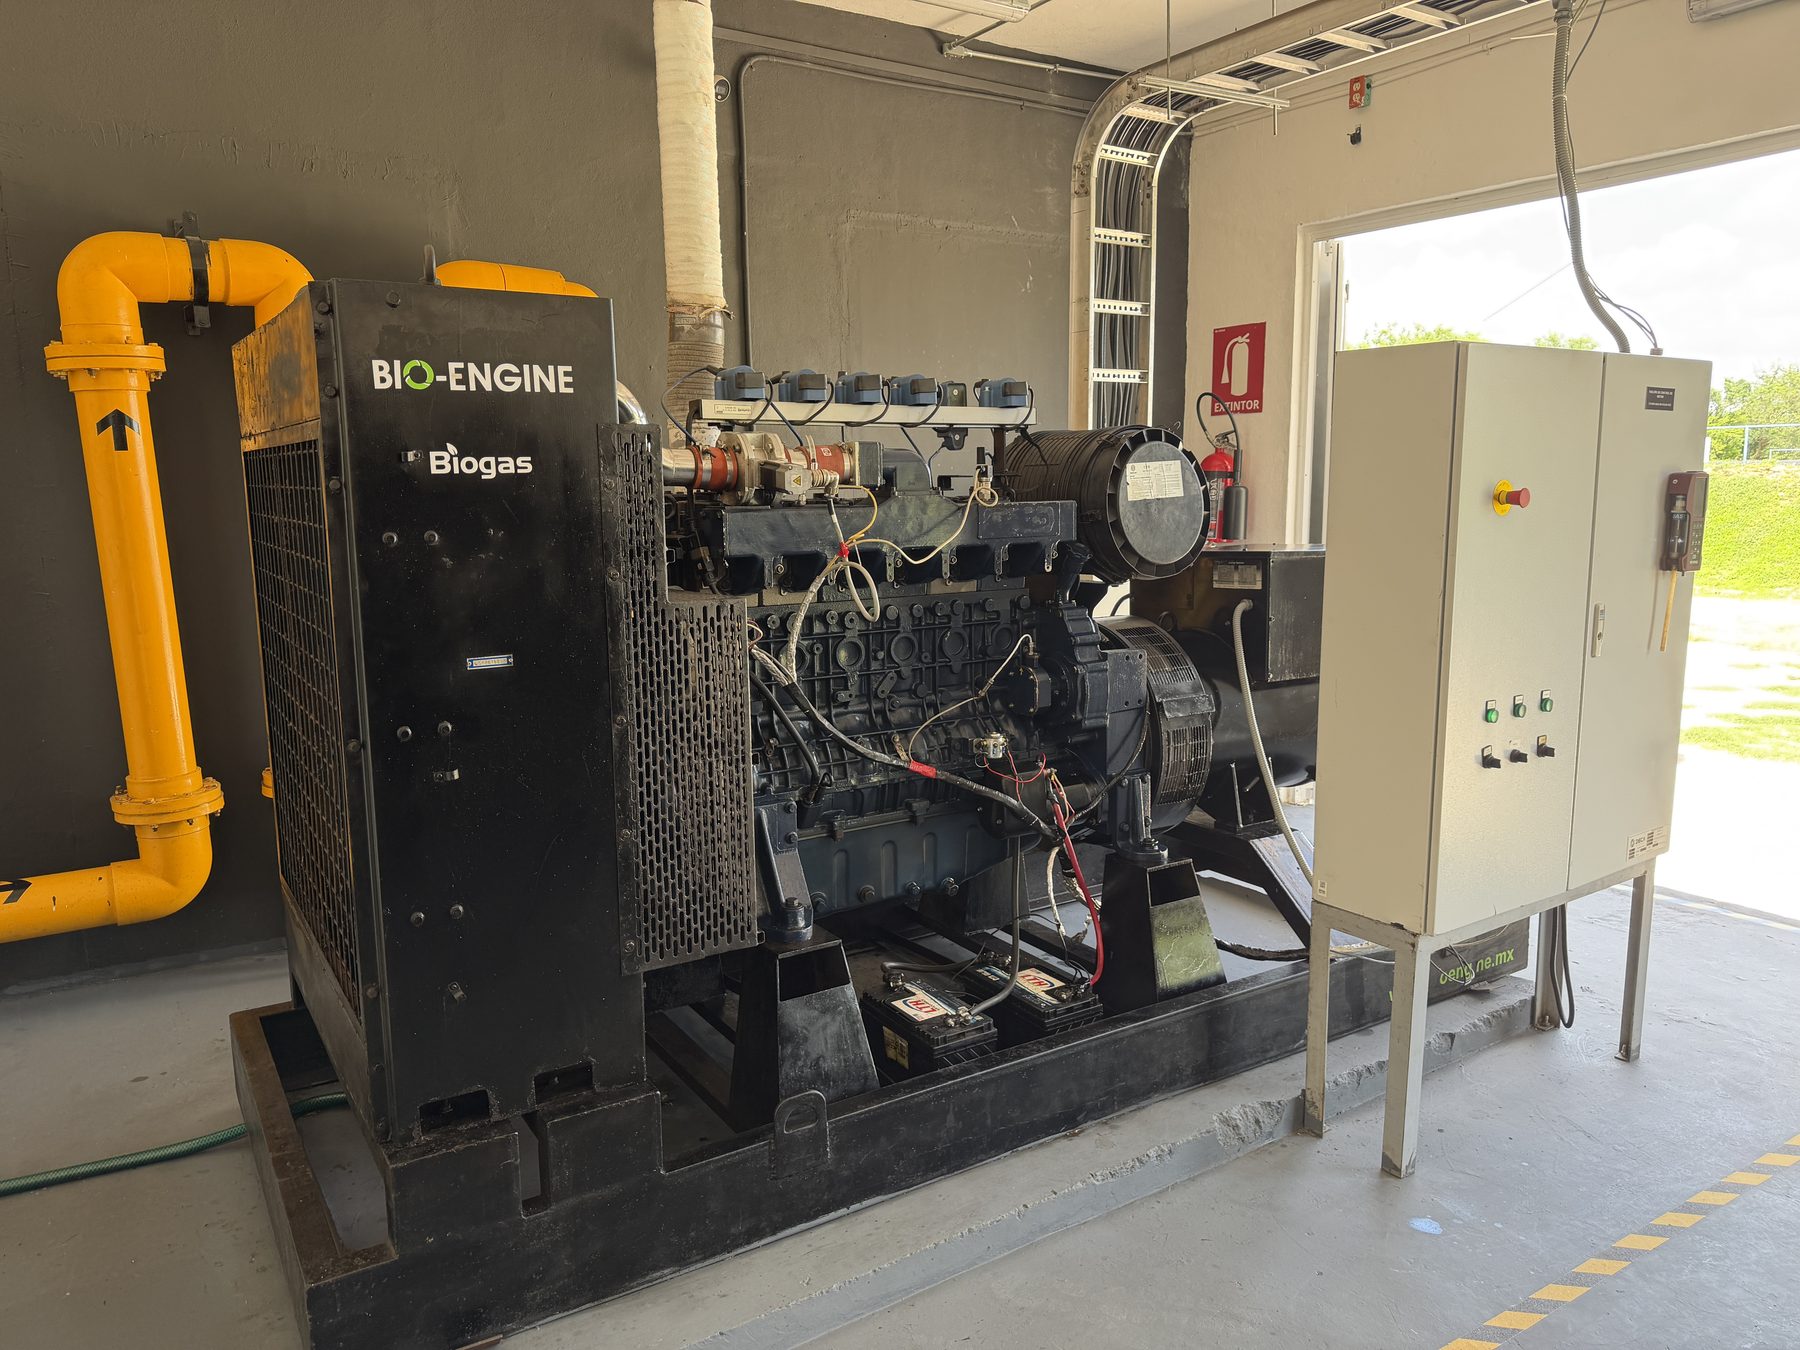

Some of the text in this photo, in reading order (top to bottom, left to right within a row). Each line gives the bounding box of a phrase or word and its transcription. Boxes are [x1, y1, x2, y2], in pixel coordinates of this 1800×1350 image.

[371, 359, 575, 394] BIO-ENGINE
[1213, 399, 1260, 413] EXTINTOR
[429, 442, 533, 480] Biogas
[908, 999, 938, 1014] LTH
